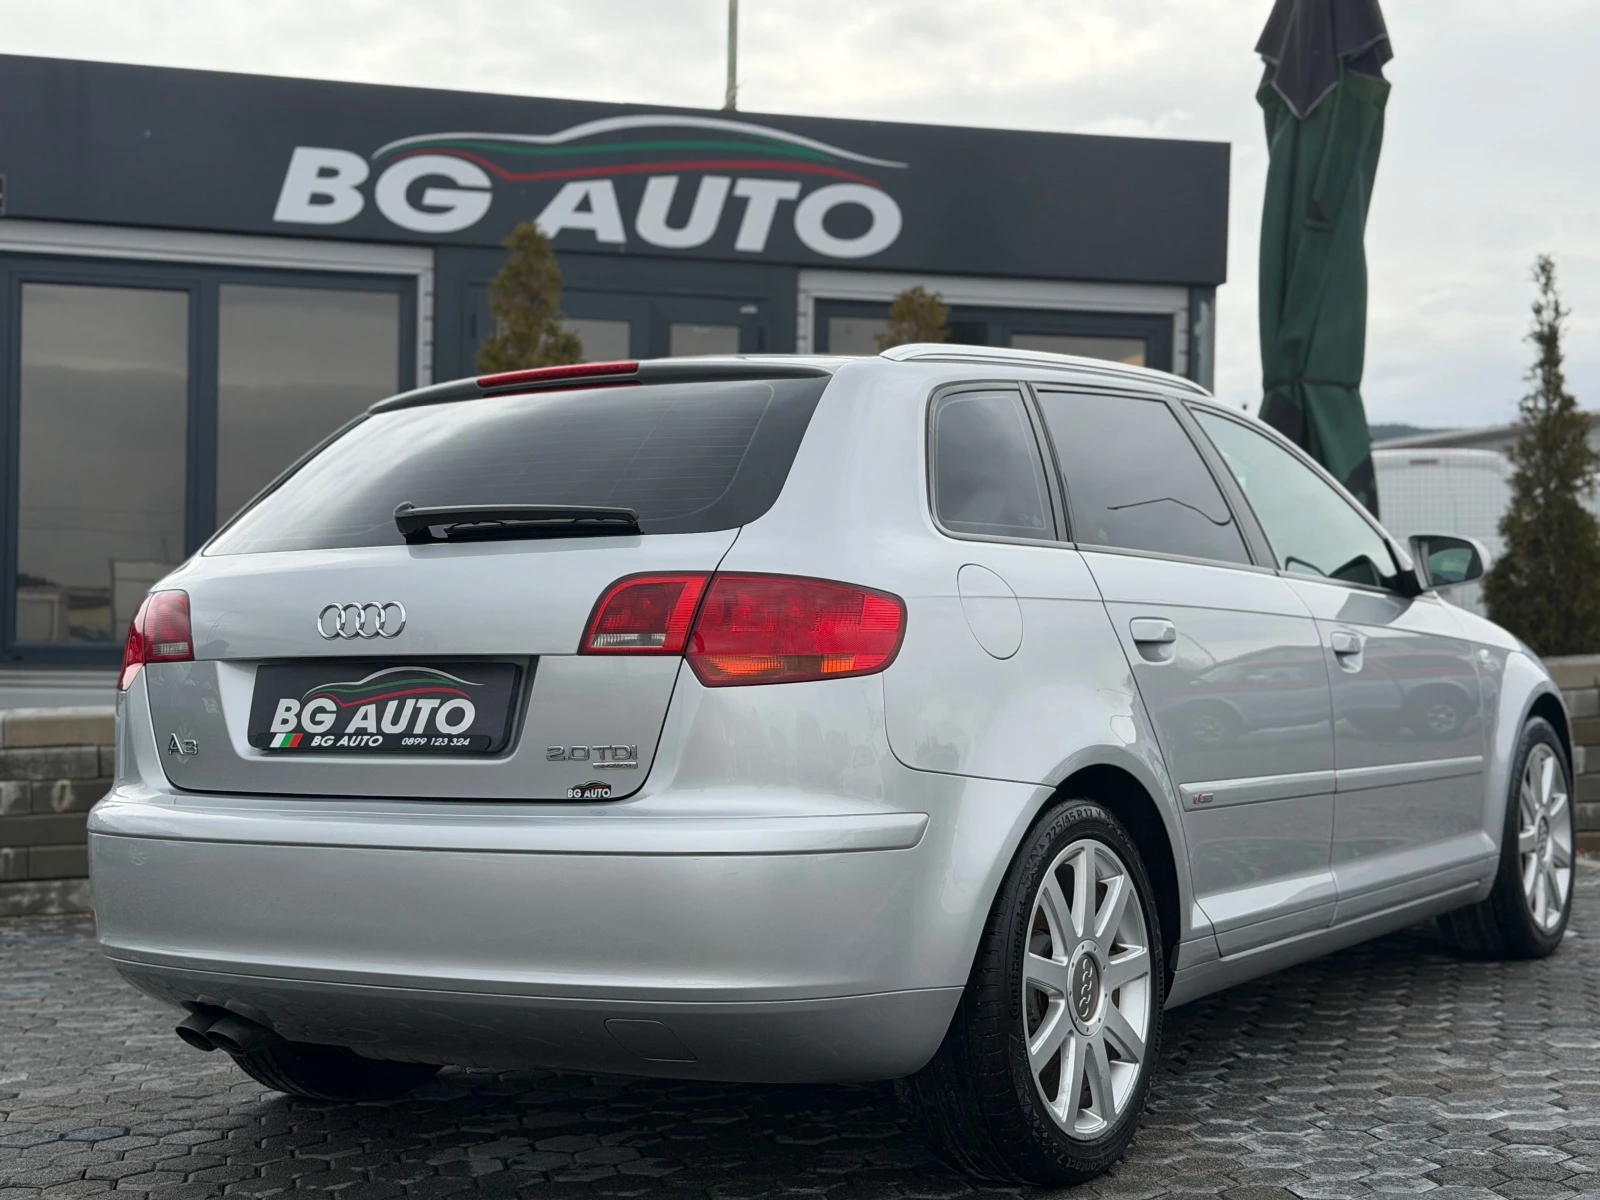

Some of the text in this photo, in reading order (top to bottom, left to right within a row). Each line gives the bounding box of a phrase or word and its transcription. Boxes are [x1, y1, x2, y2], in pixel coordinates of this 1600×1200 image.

[272, 146, 902, 259] BG AUTO
[270, 698, 476, 735] BG AUTO
[168, 733, 199, 755] A3
[311, 735, 383, 747] BG AUTO
[401, 737, 470, 746] 0899 123 324
[546, 744, 638, 761] 2.0 TDI
[567, 788, 611, 798] BG AUTO
